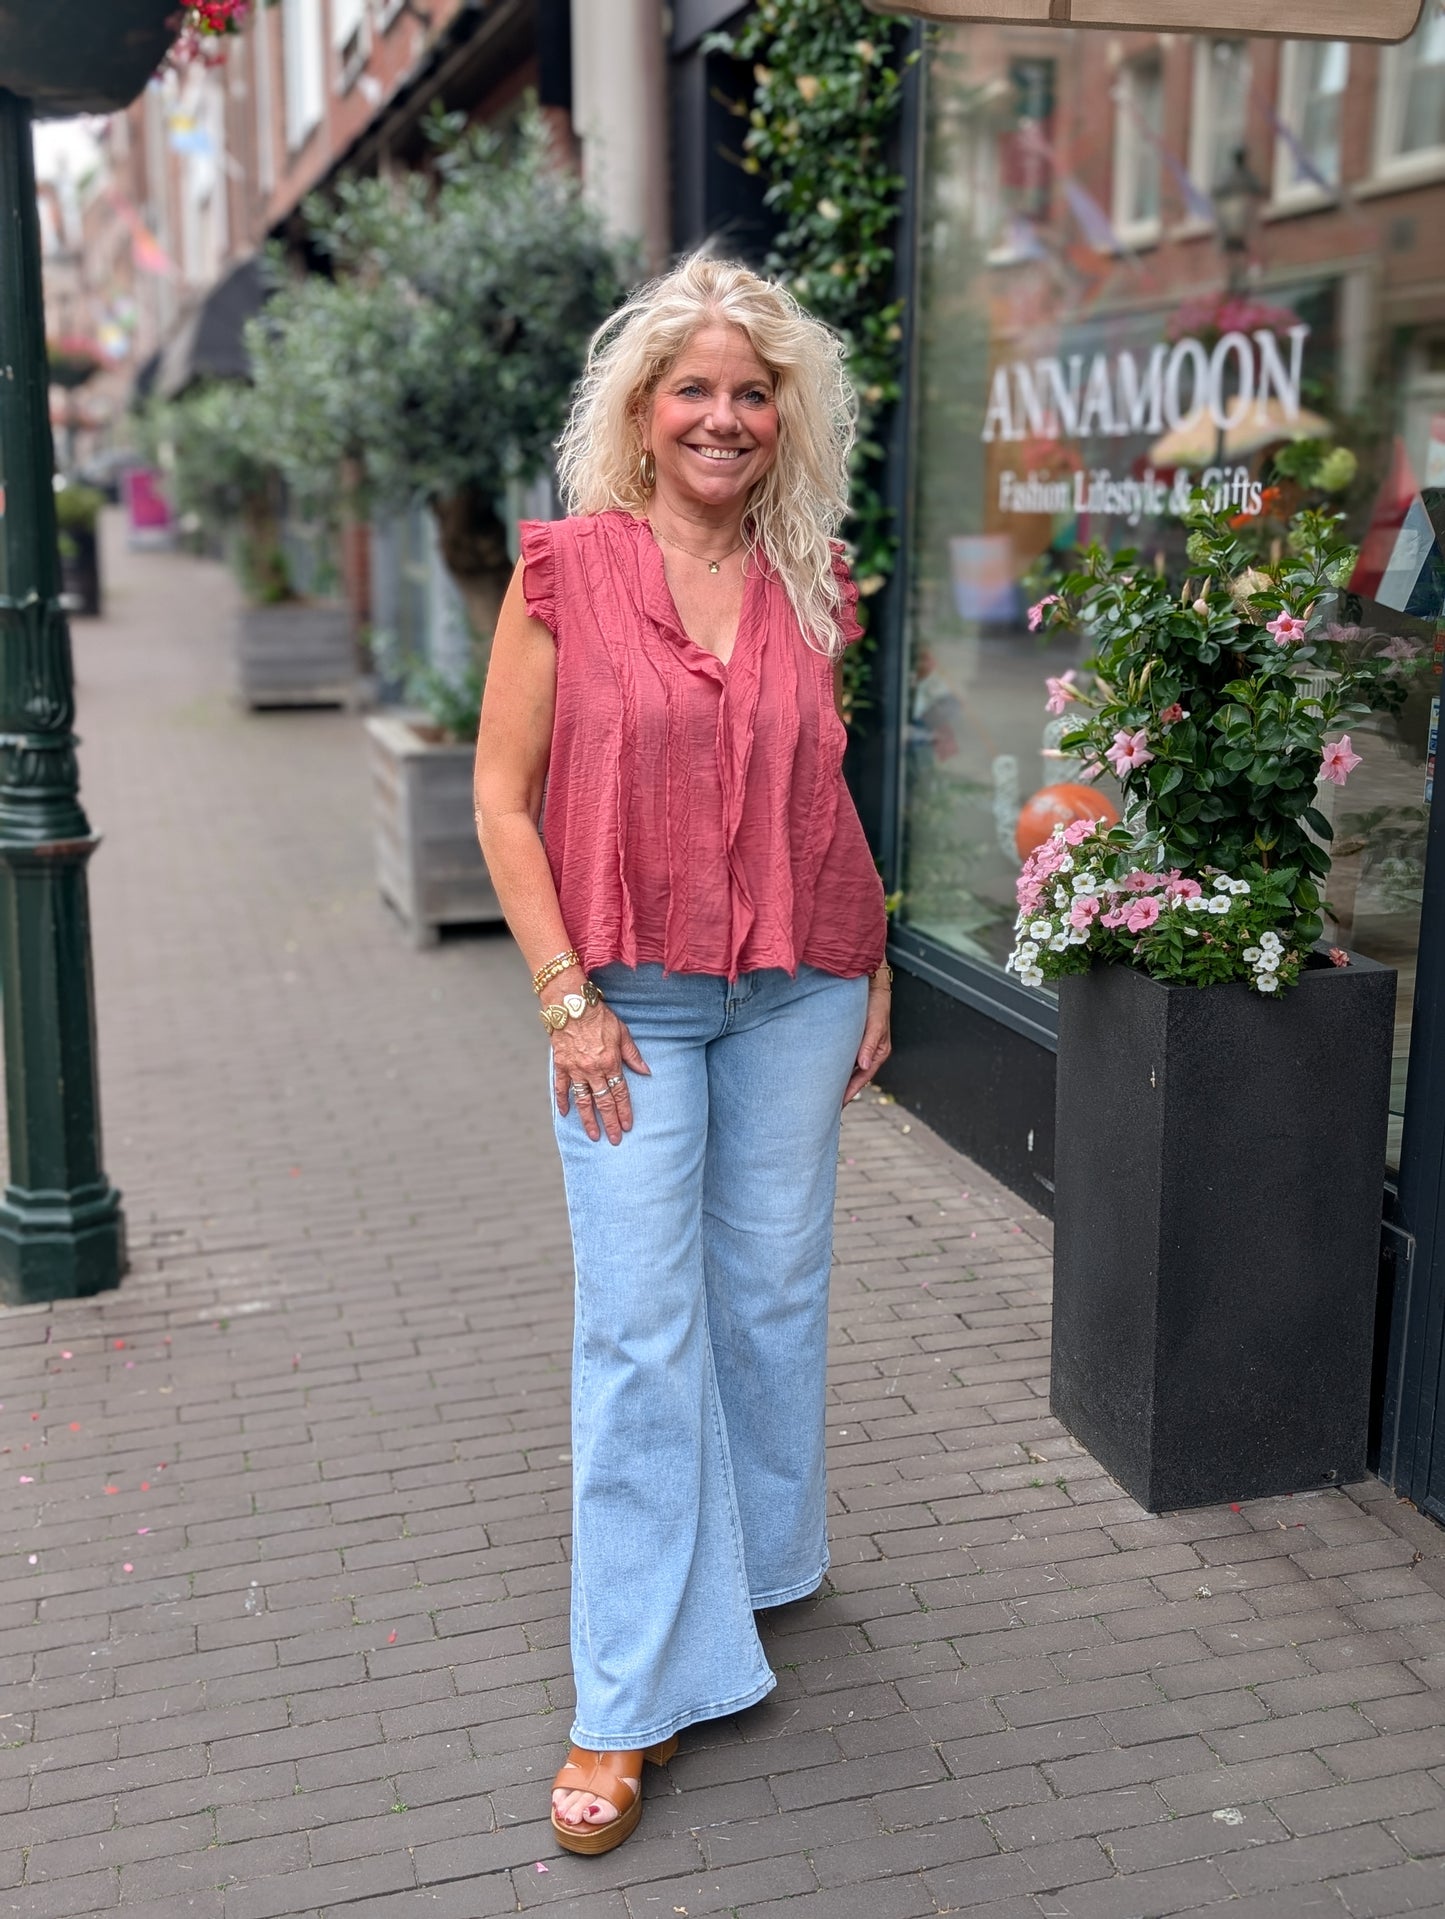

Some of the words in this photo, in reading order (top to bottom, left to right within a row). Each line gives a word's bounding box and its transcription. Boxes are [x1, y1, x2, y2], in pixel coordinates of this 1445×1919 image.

[982, 325, 1309, 442] ANNAMOON
[999, 469, 1069, 513] Fashion
[1073, 469, 1165, 525] Lifestyle
[1168, 467, 1193, 516] &
[1201, 465, 1262, 516] Gifts
